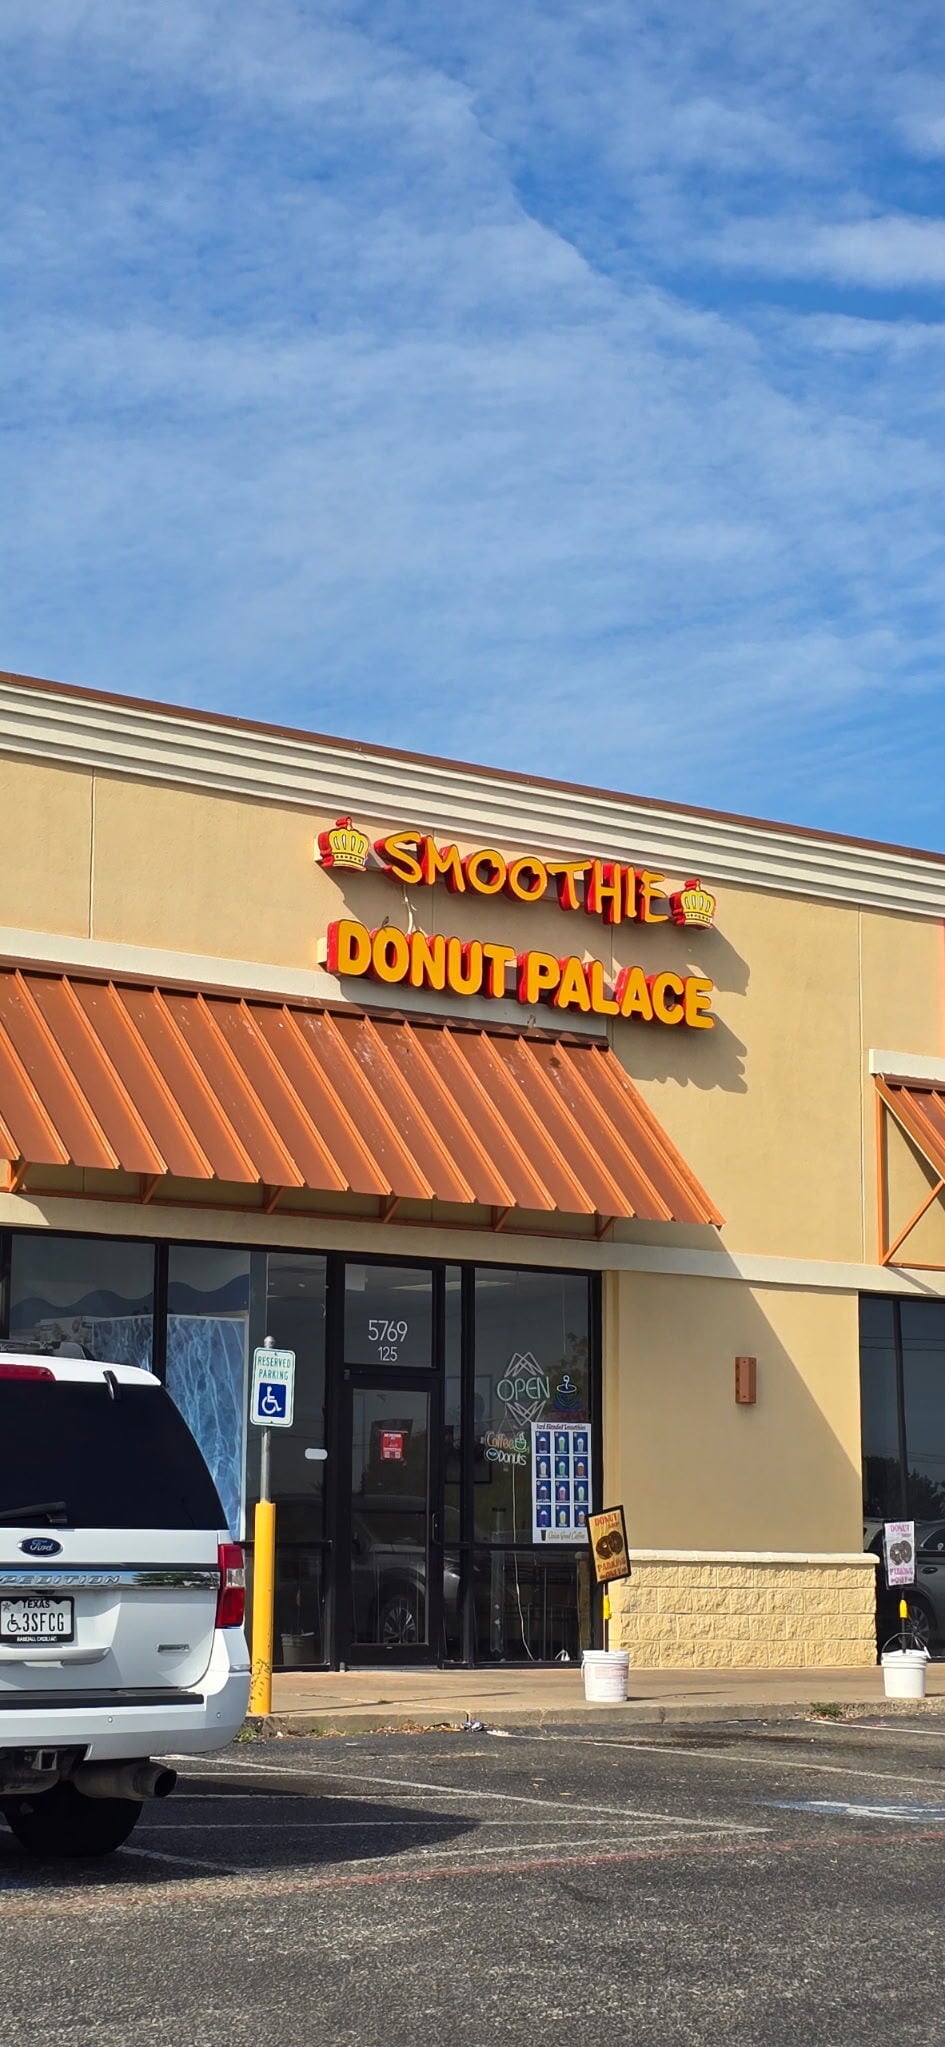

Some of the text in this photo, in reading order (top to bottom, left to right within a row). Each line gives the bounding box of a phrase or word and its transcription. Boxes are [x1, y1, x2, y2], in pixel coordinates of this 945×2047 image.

[380, 830, 669, 925] SMOOTHIE
[331, 918, 715, 1029] DONUT PALACE
[368, 1319, 408, 1342] 5769
[378, 1346, 398, 1361] 125
[257, 1355, 291, 1369] RESERVED
[258, 1368, 288, 1380] PARKING
[497, 1376, 550, 1401] OPEN
[487, 1431, 514, 1450] Coffee
[498, 1450, 527, 1466] Donuts
[594, 1512, 618, 1526] DONUT
[30, 1540, 54, 1551] Ford
[0, 1575, 120, 1585] PEDITION
[23, 1599, 50, 1609] TEXAS
[23, 1612, 65, 1632] 3SFCG
